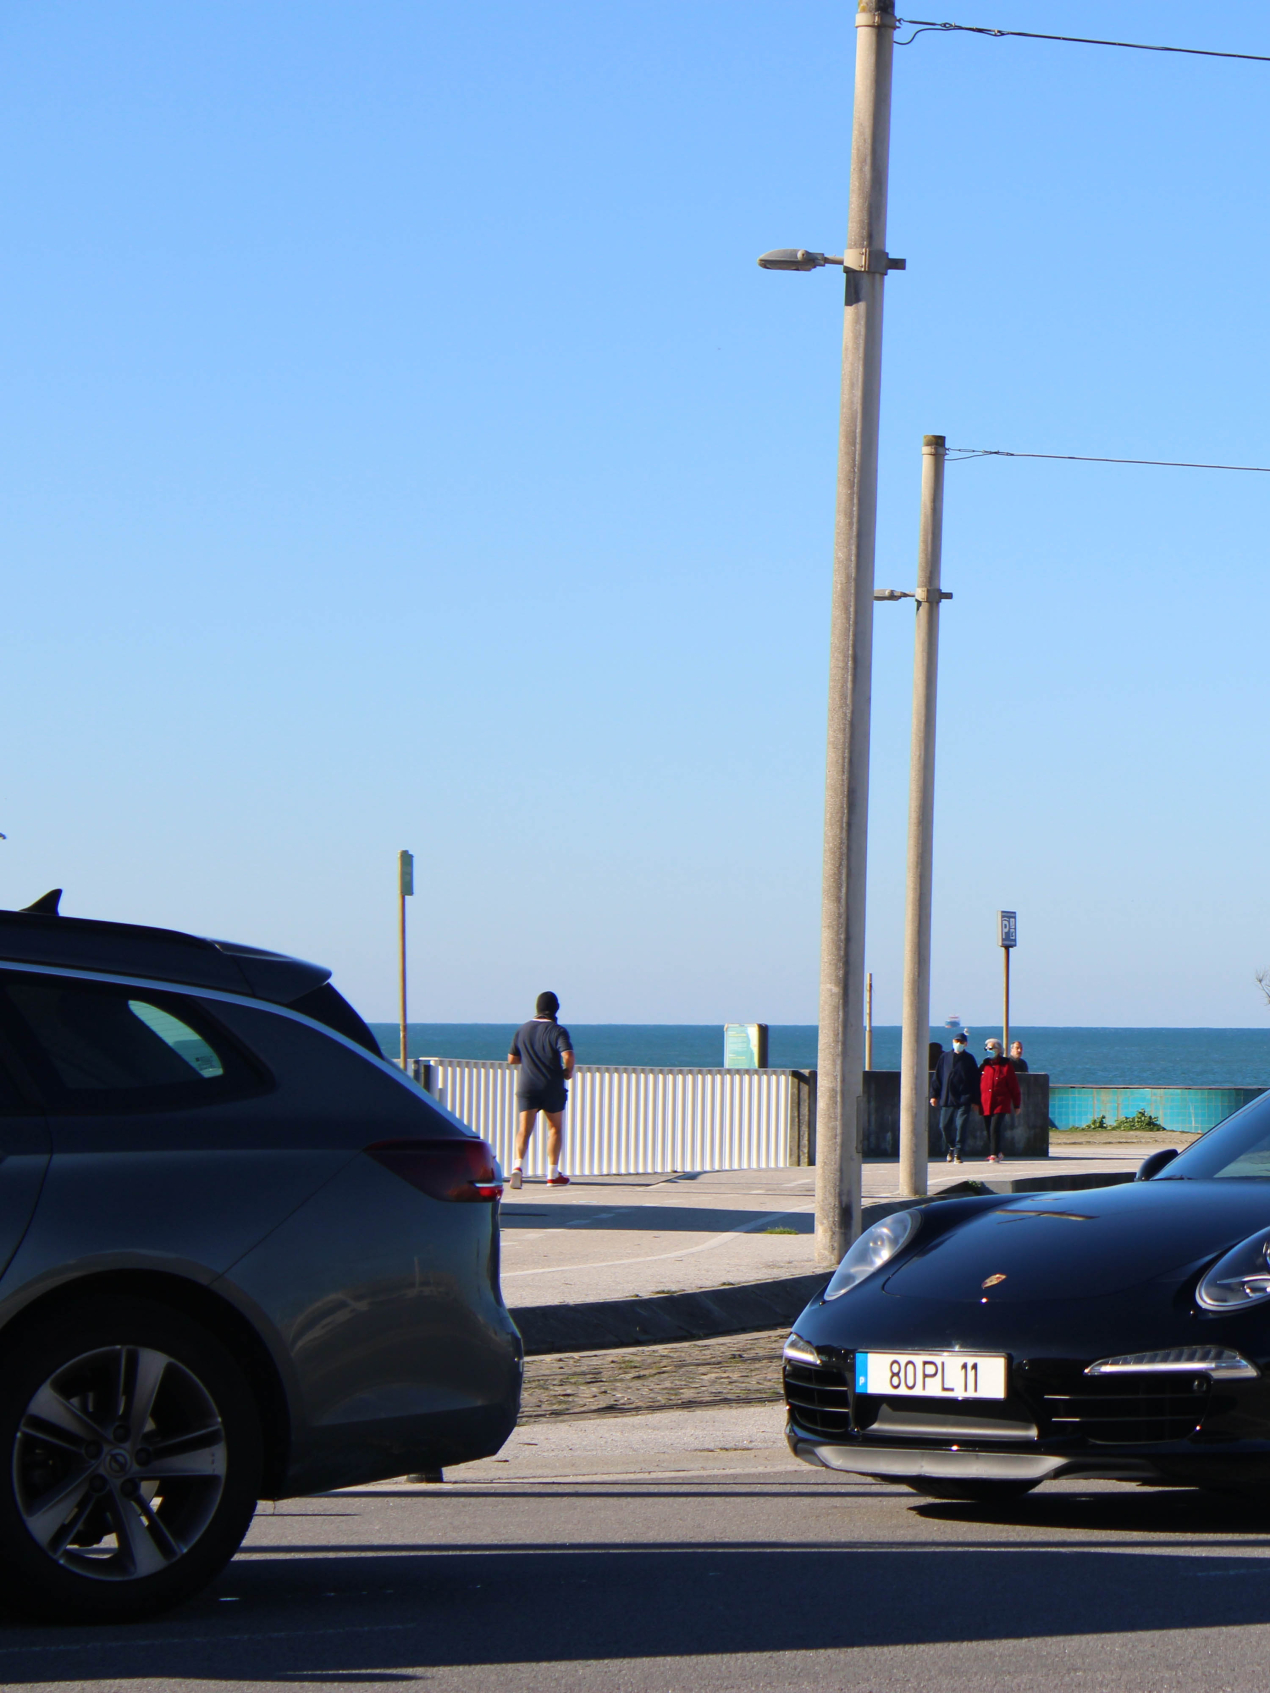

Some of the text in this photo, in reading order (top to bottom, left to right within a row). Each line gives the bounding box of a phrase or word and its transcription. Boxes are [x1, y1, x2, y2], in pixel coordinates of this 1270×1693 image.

[1002, 920, 1010, 939] P
[859, 1359, 978, 1393] P 80 PL 11
